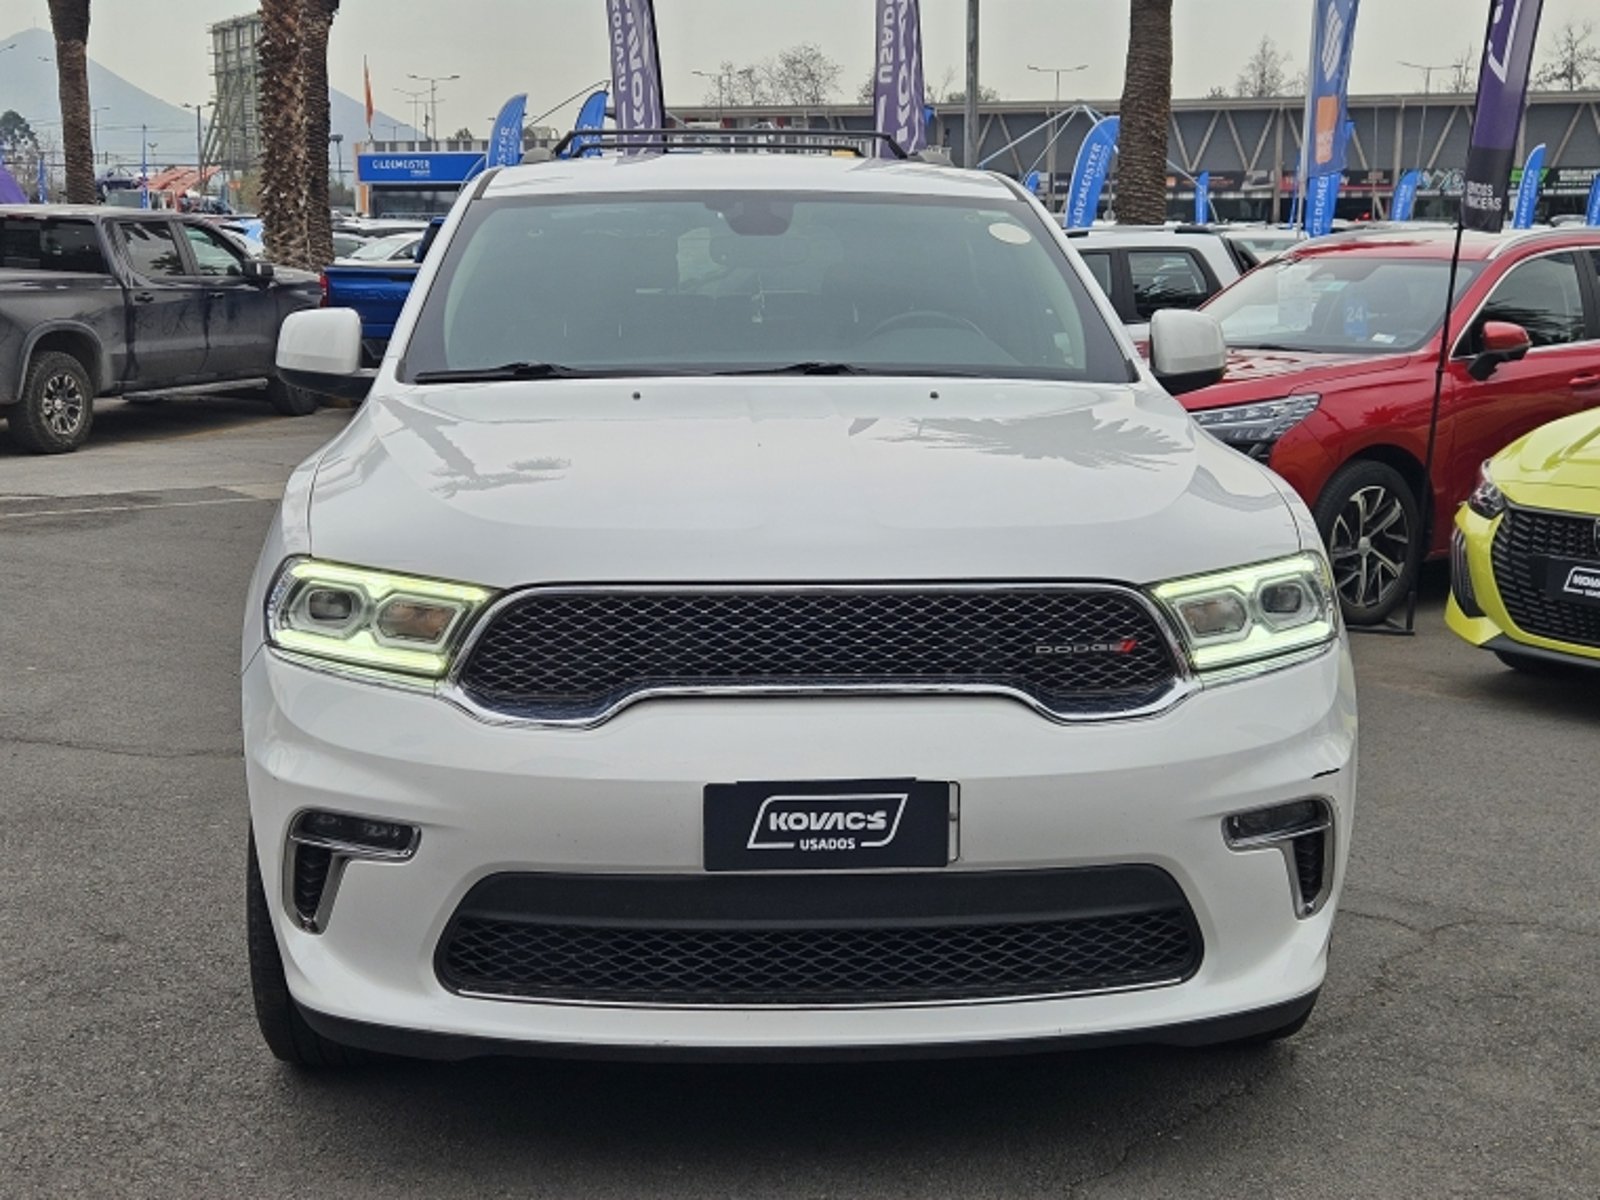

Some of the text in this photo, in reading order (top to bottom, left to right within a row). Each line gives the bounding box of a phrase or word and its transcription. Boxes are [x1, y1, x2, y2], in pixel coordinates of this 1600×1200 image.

[1346, 307, 1363, 322] 24
[769, 811, 887, 831] KOVACS
[800, 838, 856, 850] USADOS
